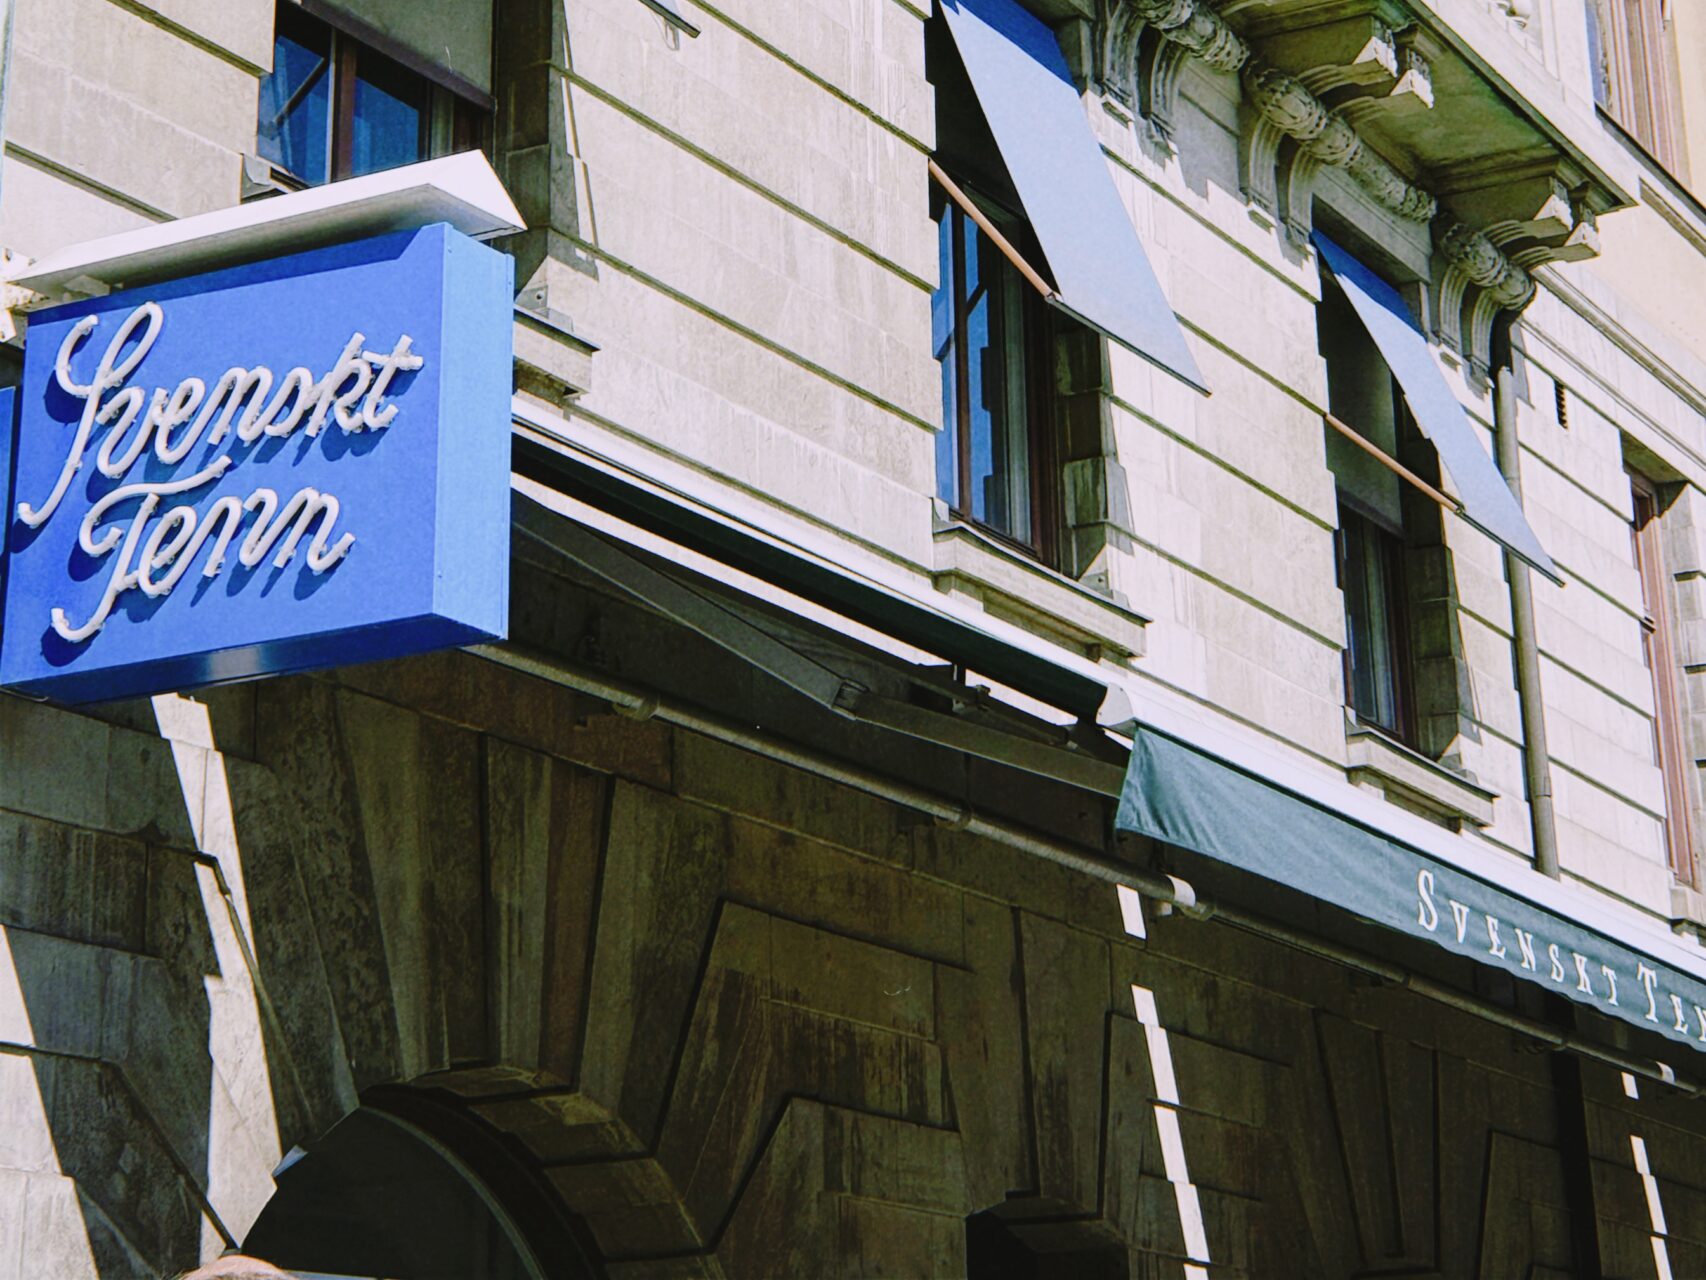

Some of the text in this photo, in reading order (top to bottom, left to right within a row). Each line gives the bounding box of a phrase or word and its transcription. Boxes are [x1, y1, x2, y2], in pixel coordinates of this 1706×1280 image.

[17, 301, 424, 528] Svenskt
[51, 455, 357, 643] Tenn
[1416, 868, 1619, 1007] SVENSKT
